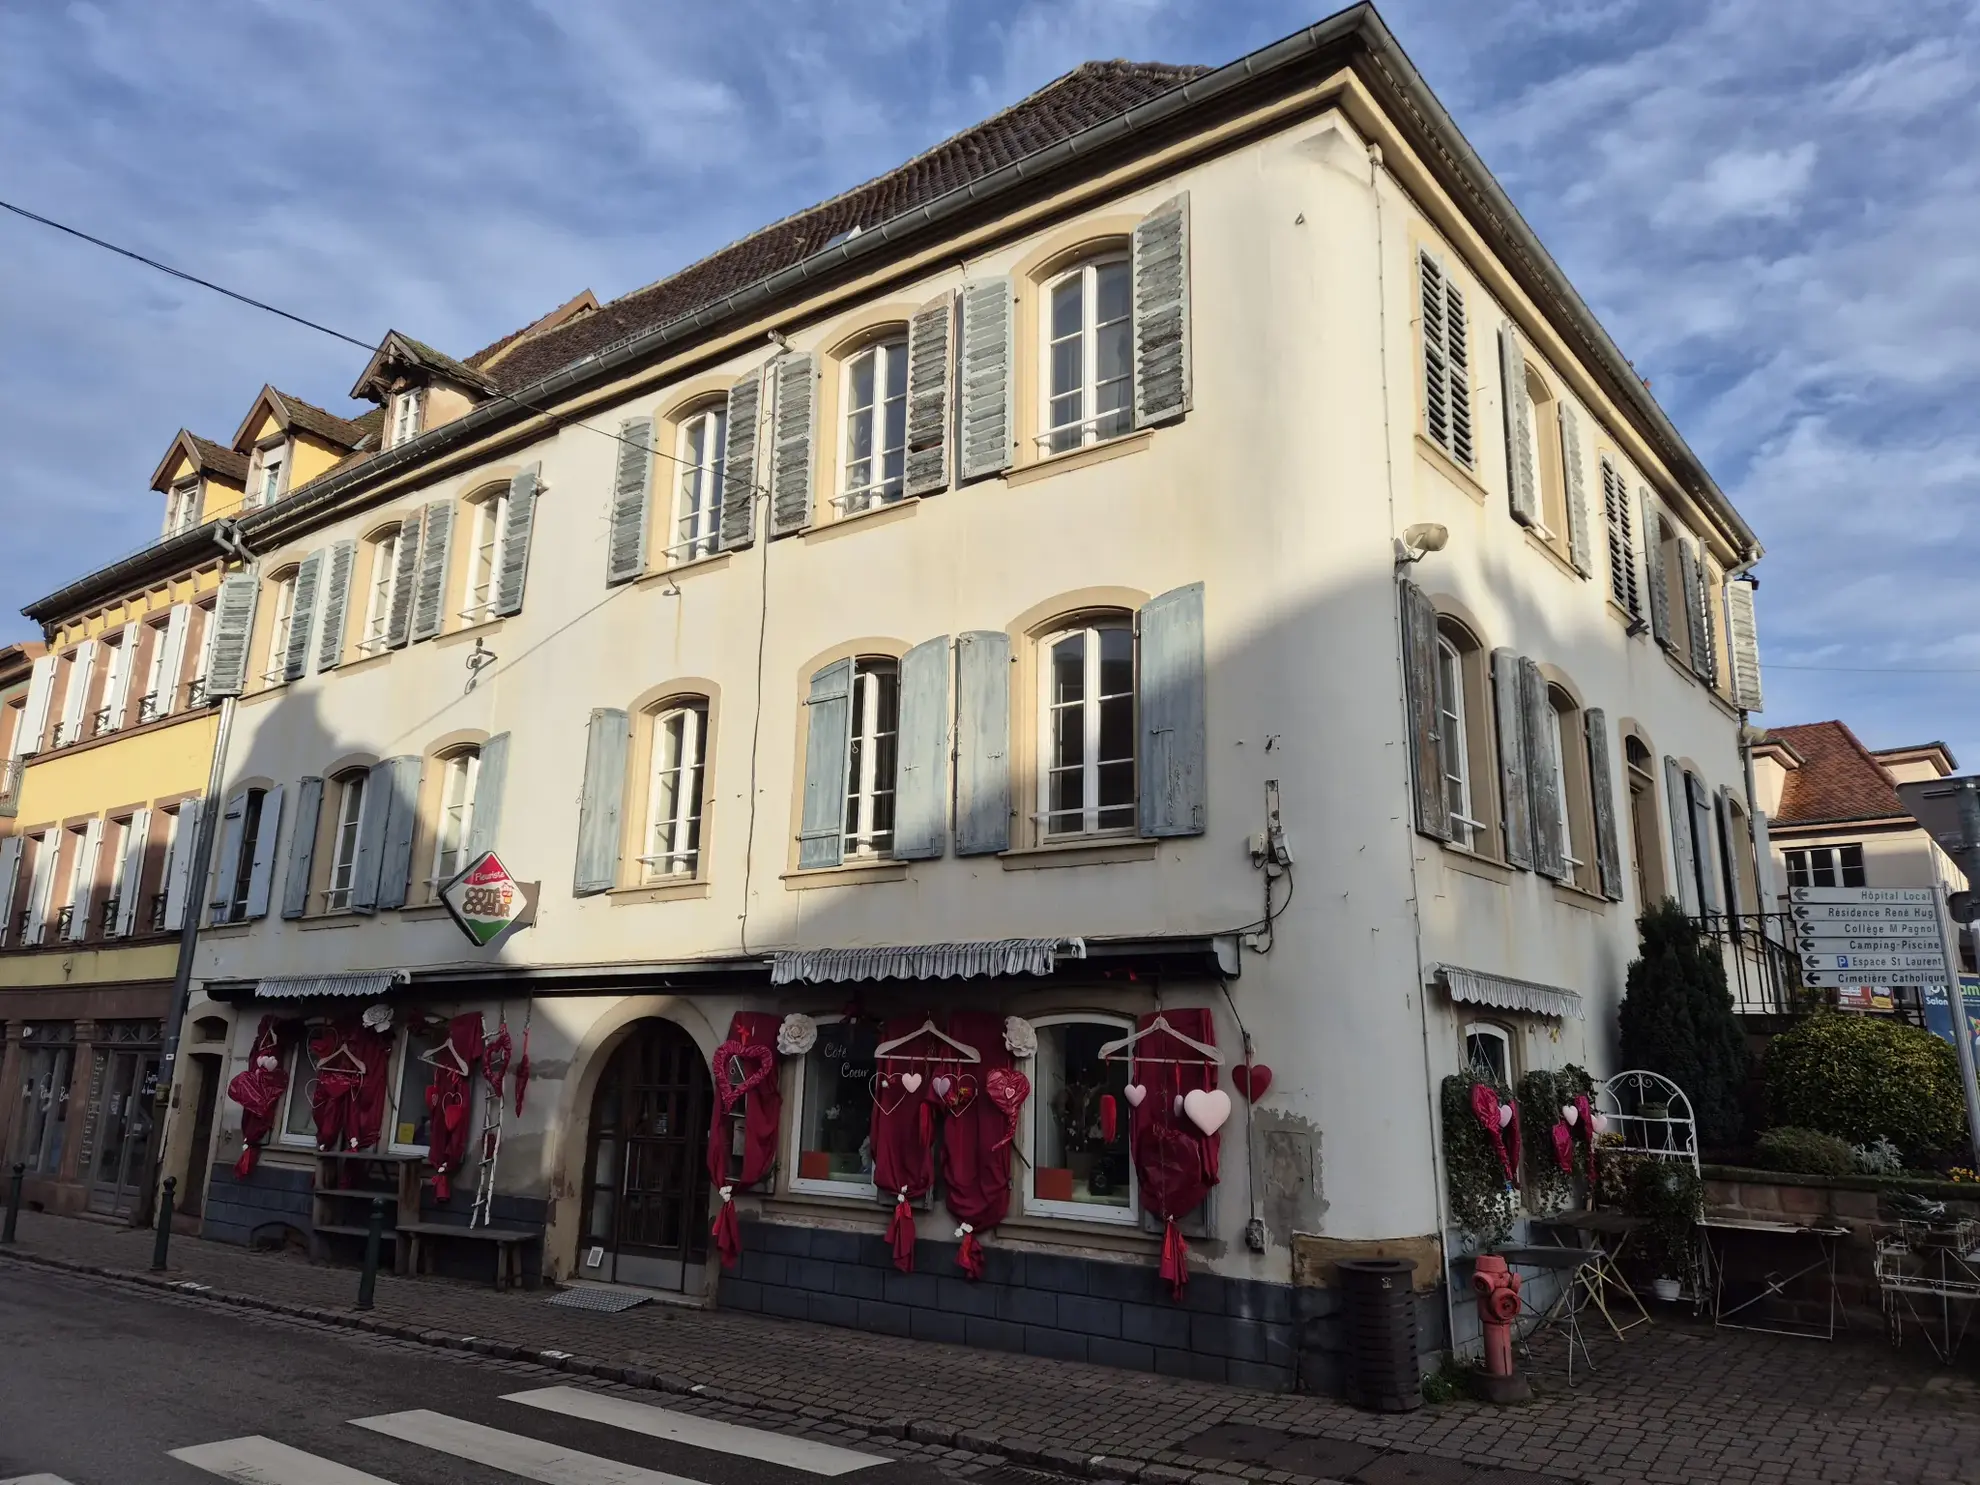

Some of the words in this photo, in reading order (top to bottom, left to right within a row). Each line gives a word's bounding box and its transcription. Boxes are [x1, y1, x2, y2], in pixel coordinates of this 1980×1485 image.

[1904, 892, 1931, 901] Local
[1828, 907, 1880, 917] Résidence
[1885, 907, 1909, 917] René
[1914, 907, 1934, 919] Hug
[1844, 923, 1884, 935] Collège
[1849, 940, 1940, 952] Camping-Piscine
[1852, 957, 1886, 968] Espace
[1891, 957, 1901, 966] St
[1906, 957, 1942, 967] Laurent
[1838, 973, 1887, 983] Cimetière
[1891, 973, 1945, 984] Catholique
